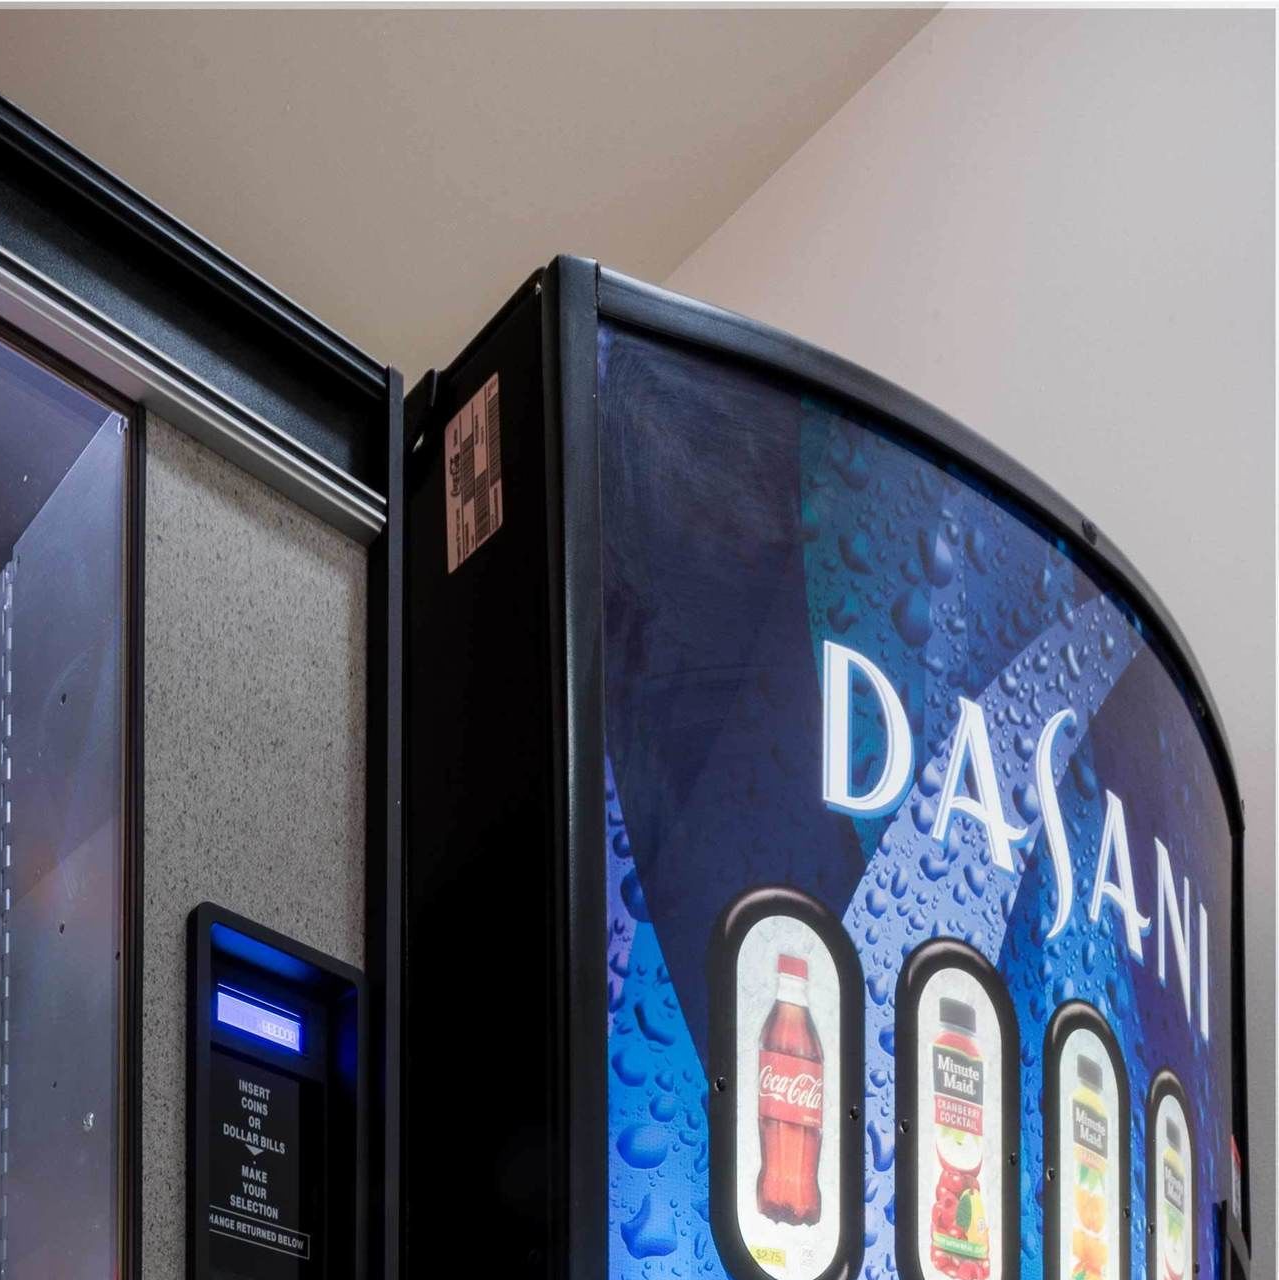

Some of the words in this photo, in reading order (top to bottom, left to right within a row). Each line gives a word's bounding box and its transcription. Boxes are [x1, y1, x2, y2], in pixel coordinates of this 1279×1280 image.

[822, 639, 1211, 1043] DASANI
[936, 1052, 981, 1080] Minute
[238, 1078, 271, 1101] INSERT
[759, 1063, 825, 1110] Coca-Cola
[942, 1070, 976, 1094] Maid
[241, 1097, 269, 1117] COINS
[936, 1095, 981, 1120] CRANBERRY
[247, 1115, 262, 1131] OR
[939, 1109, 979, 1130] COCKTAIL
[1075, 1105, 1107, 1136] Minute
[222, 1122, 260, 1146] DOLLAR
[259, 1135, 286, 1155] BILLS
[1079, 1122, 1102, 1146] Maid
[241, 1164, 268, 1185] MAKE
[242, 1181, 268, 1201] YOUR
[229, 1193, 280, 1221] SELECTION
[236, 1220, 278, 1243] RETURNED
[277, 1233, 305, 1251] BELOW
